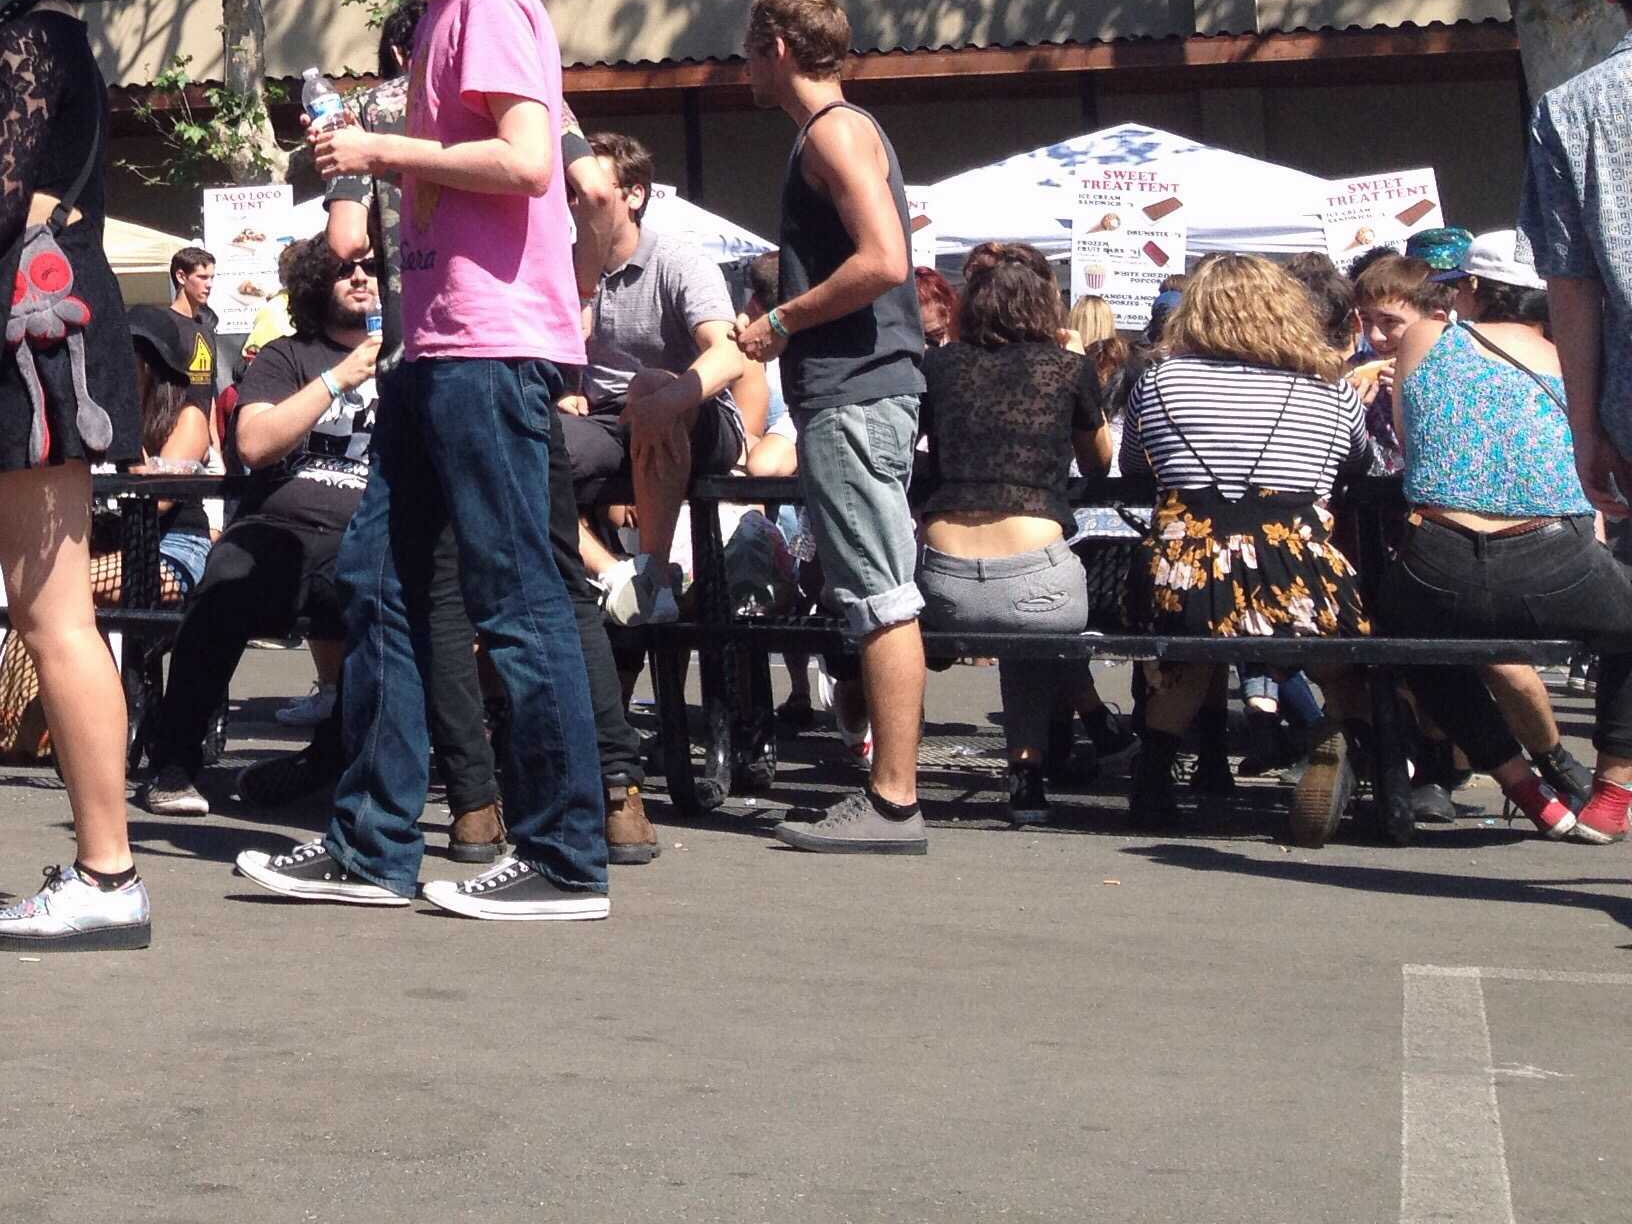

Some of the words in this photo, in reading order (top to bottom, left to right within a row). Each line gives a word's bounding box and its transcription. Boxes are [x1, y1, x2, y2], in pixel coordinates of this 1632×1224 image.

[1103, 170, 1158, 181] SWEET
[1081, 180, 1133, 191] TREAT
[1138, 182, 1180, 193] TENT
[1348, 177, 1403, 194] SWEET
[215, 192, 246, 202] TACO
[249, 190, 282, 200] LOCO
[1327, 192, 1380, 206] TREAT
[1384, 184, 1429, 199] TENT
[232, 201, 264, 210] TENT
